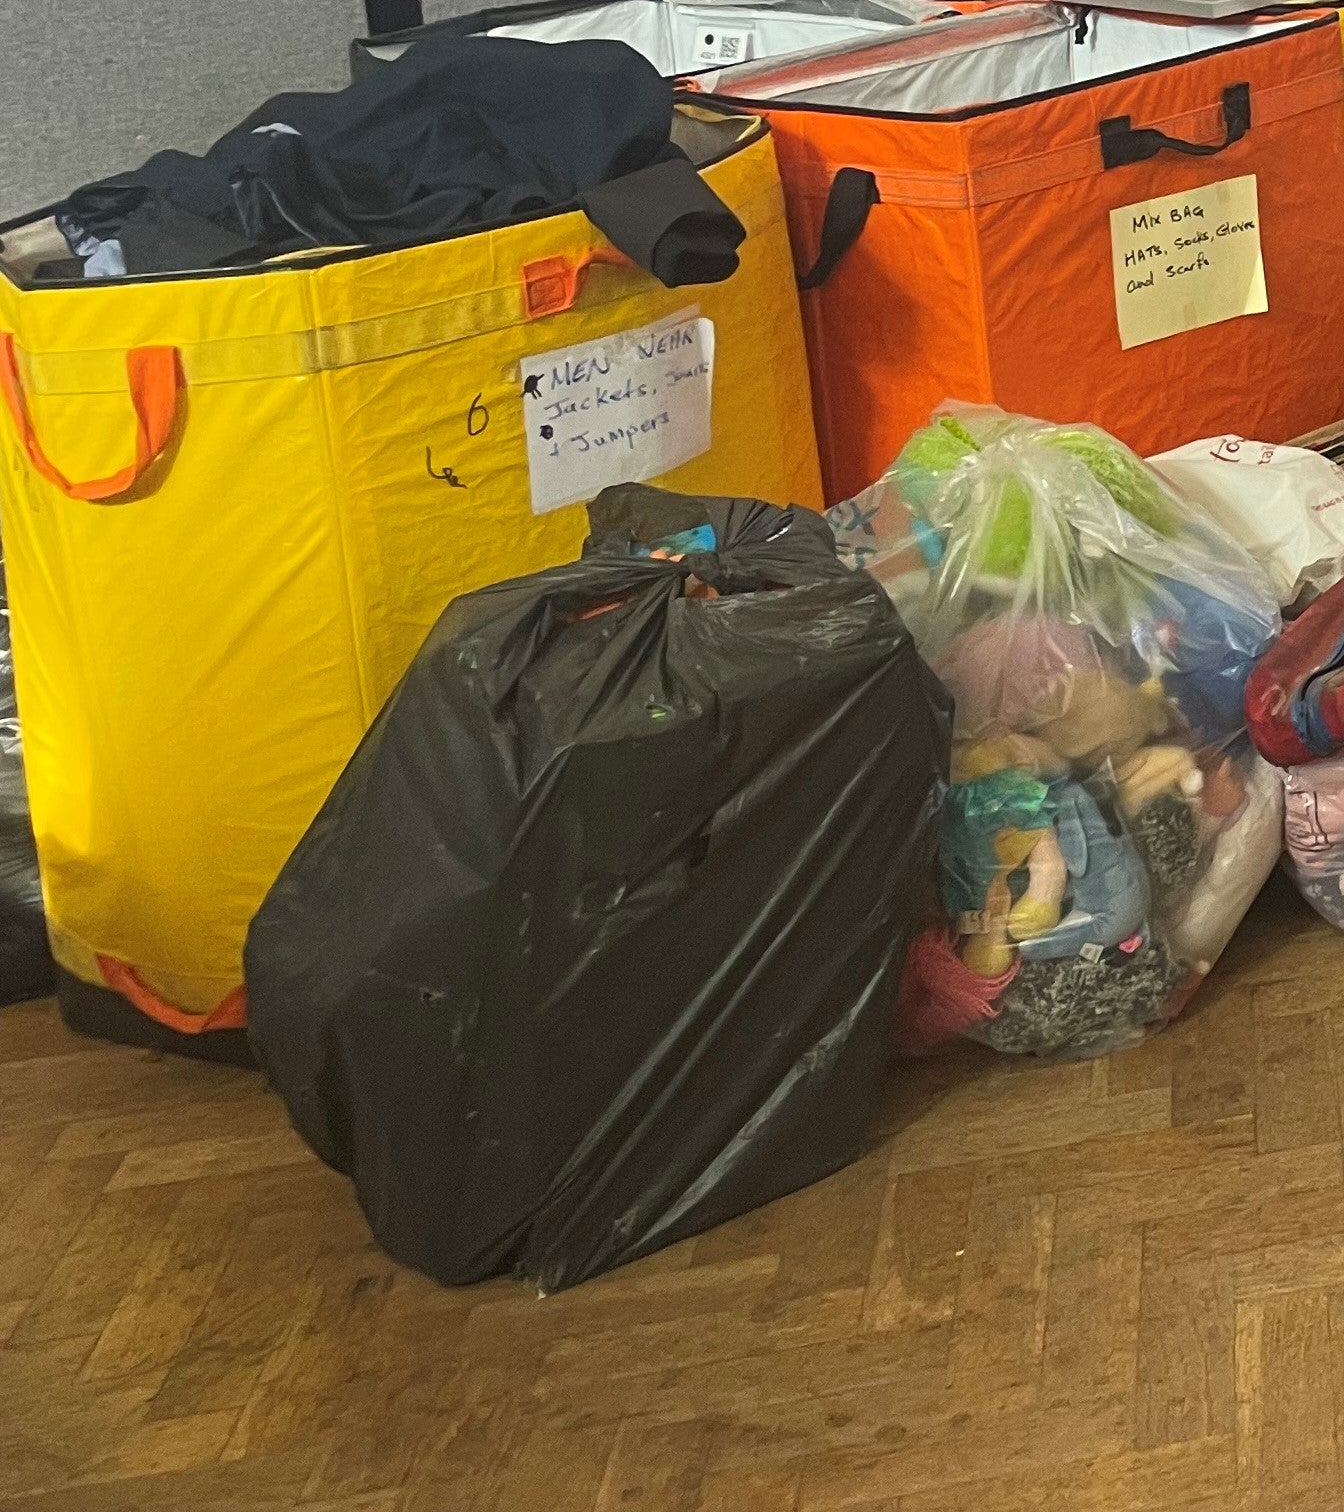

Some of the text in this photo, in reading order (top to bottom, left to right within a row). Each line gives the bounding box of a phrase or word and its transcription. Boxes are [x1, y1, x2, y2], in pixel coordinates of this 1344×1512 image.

[1169, 205, 1205, 223] BAG
[550, 355, 610, 391] MEN
[572, 410, 671, 453] Jumpers
